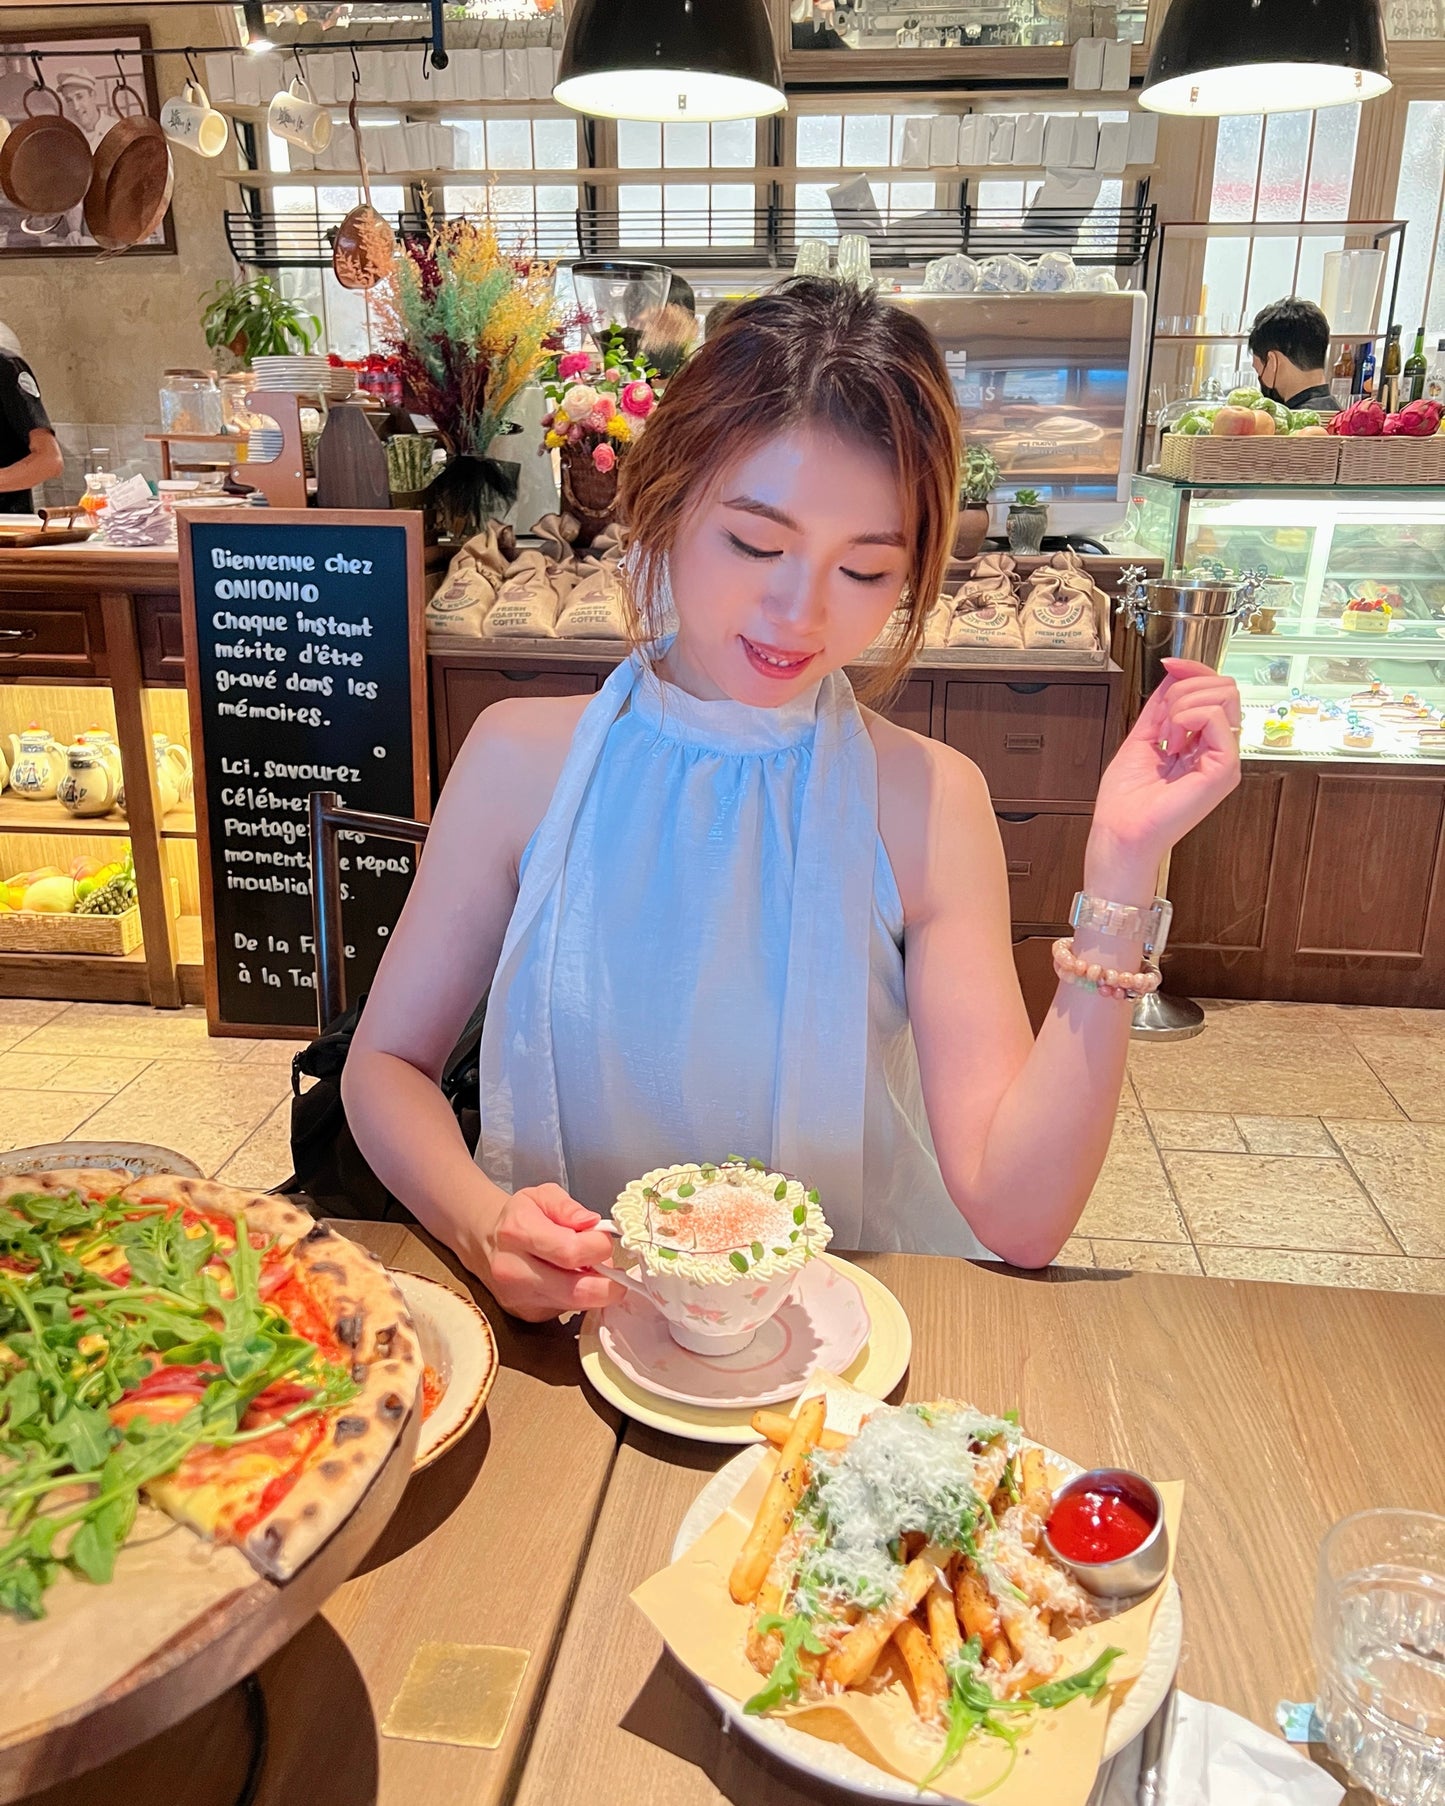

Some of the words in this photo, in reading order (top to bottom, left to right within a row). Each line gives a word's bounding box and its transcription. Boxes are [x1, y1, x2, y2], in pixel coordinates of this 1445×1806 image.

[211, 548, 315, 572] Bienvenue
[324, 553, 373, 575] chez
[214, 579, 319, 603] ONIONIO
[212, 611, 288, 637] Chaque
[296, 611, 373, 637] instant
[492, 618, 528, 626] COFFEE
[570, 616, 608, 624] COFFEE
[214, 638, 287, 662] mérite
[299, 643, 363, 667] d'être
[215, 669, 277, 692] gravé
[286, 672, 334, 696] dans
[348, 678, 378, 700] les
[218, 698, 331, 727] mémoires.
[224, 818, 310, 844] Partage
[356, 855, 410, 878] repas
[234, 933, 258, 951] De
[268, 936, 289, 953] la
[238, 962, 251, 984] à
[261, 967, 281, 988] la
